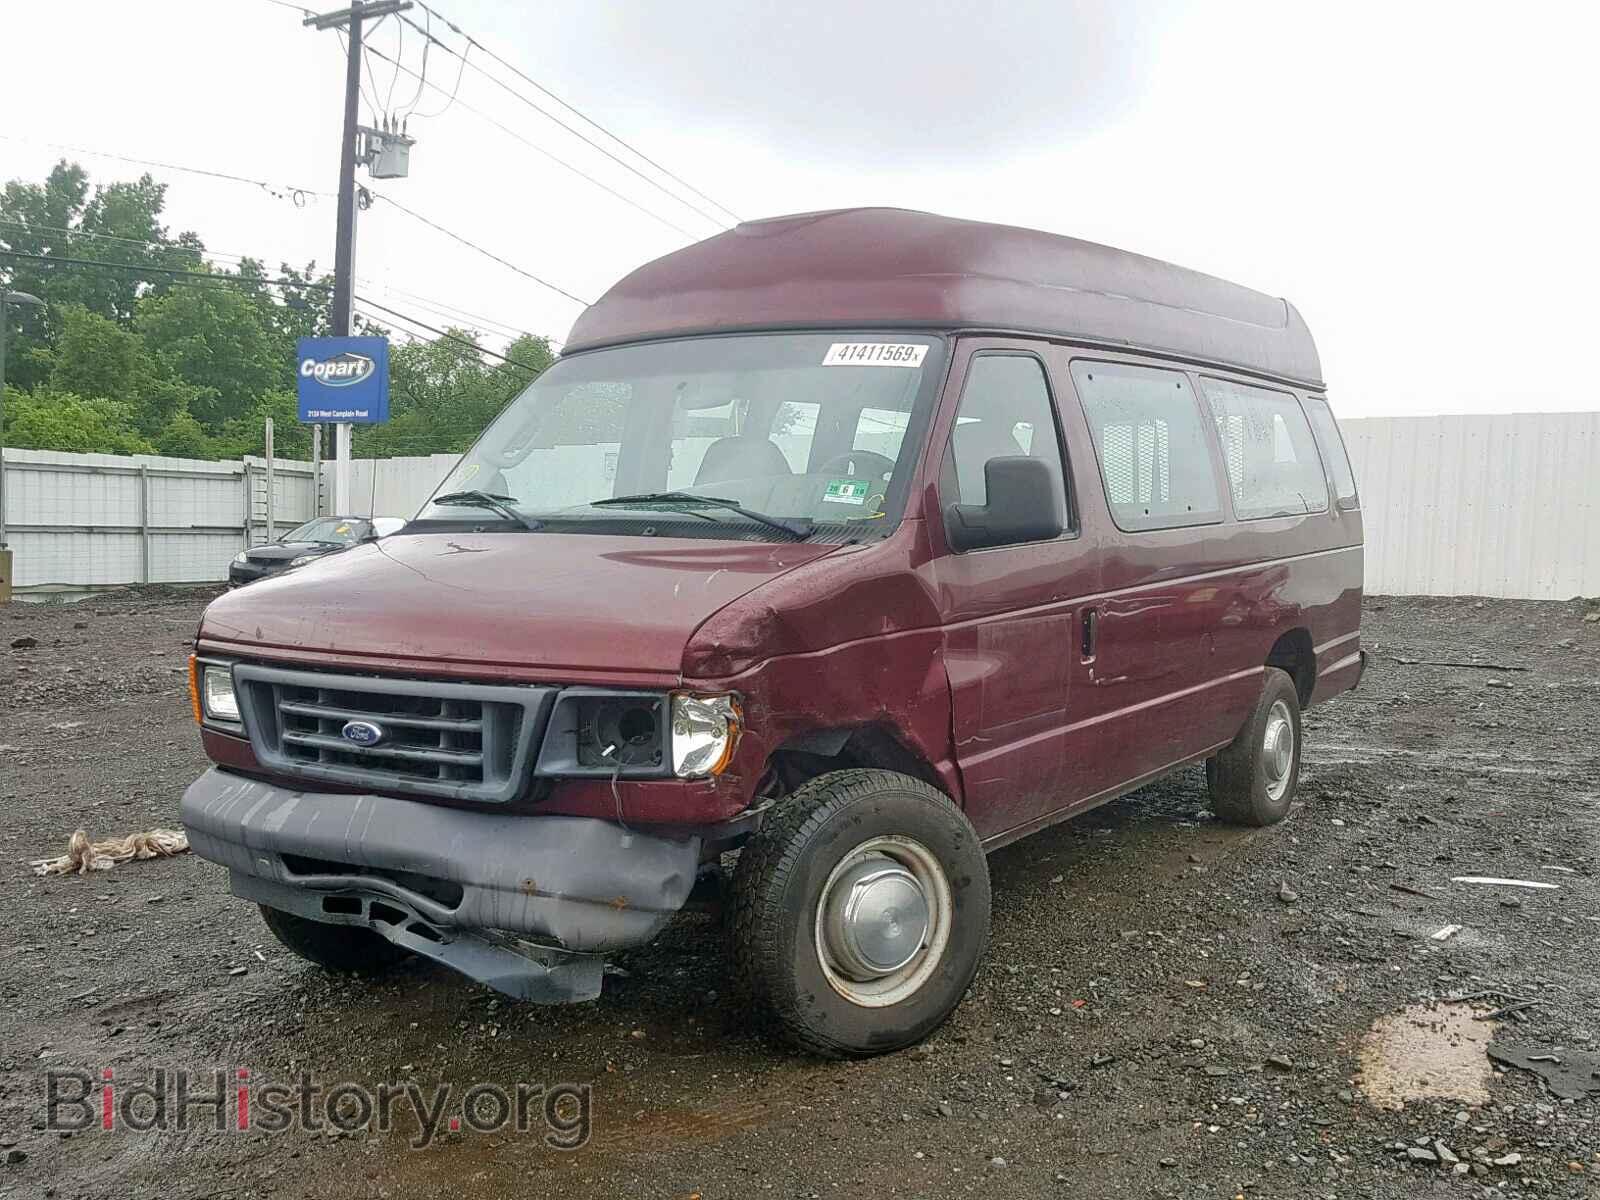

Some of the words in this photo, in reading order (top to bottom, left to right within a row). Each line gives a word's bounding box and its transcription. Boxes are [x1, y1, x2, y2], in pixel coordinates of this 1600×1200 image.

[301, 358, 366, 380] Copart
[355, 409, 369, 418] Road
[351, 726, 369, 740] Ford
